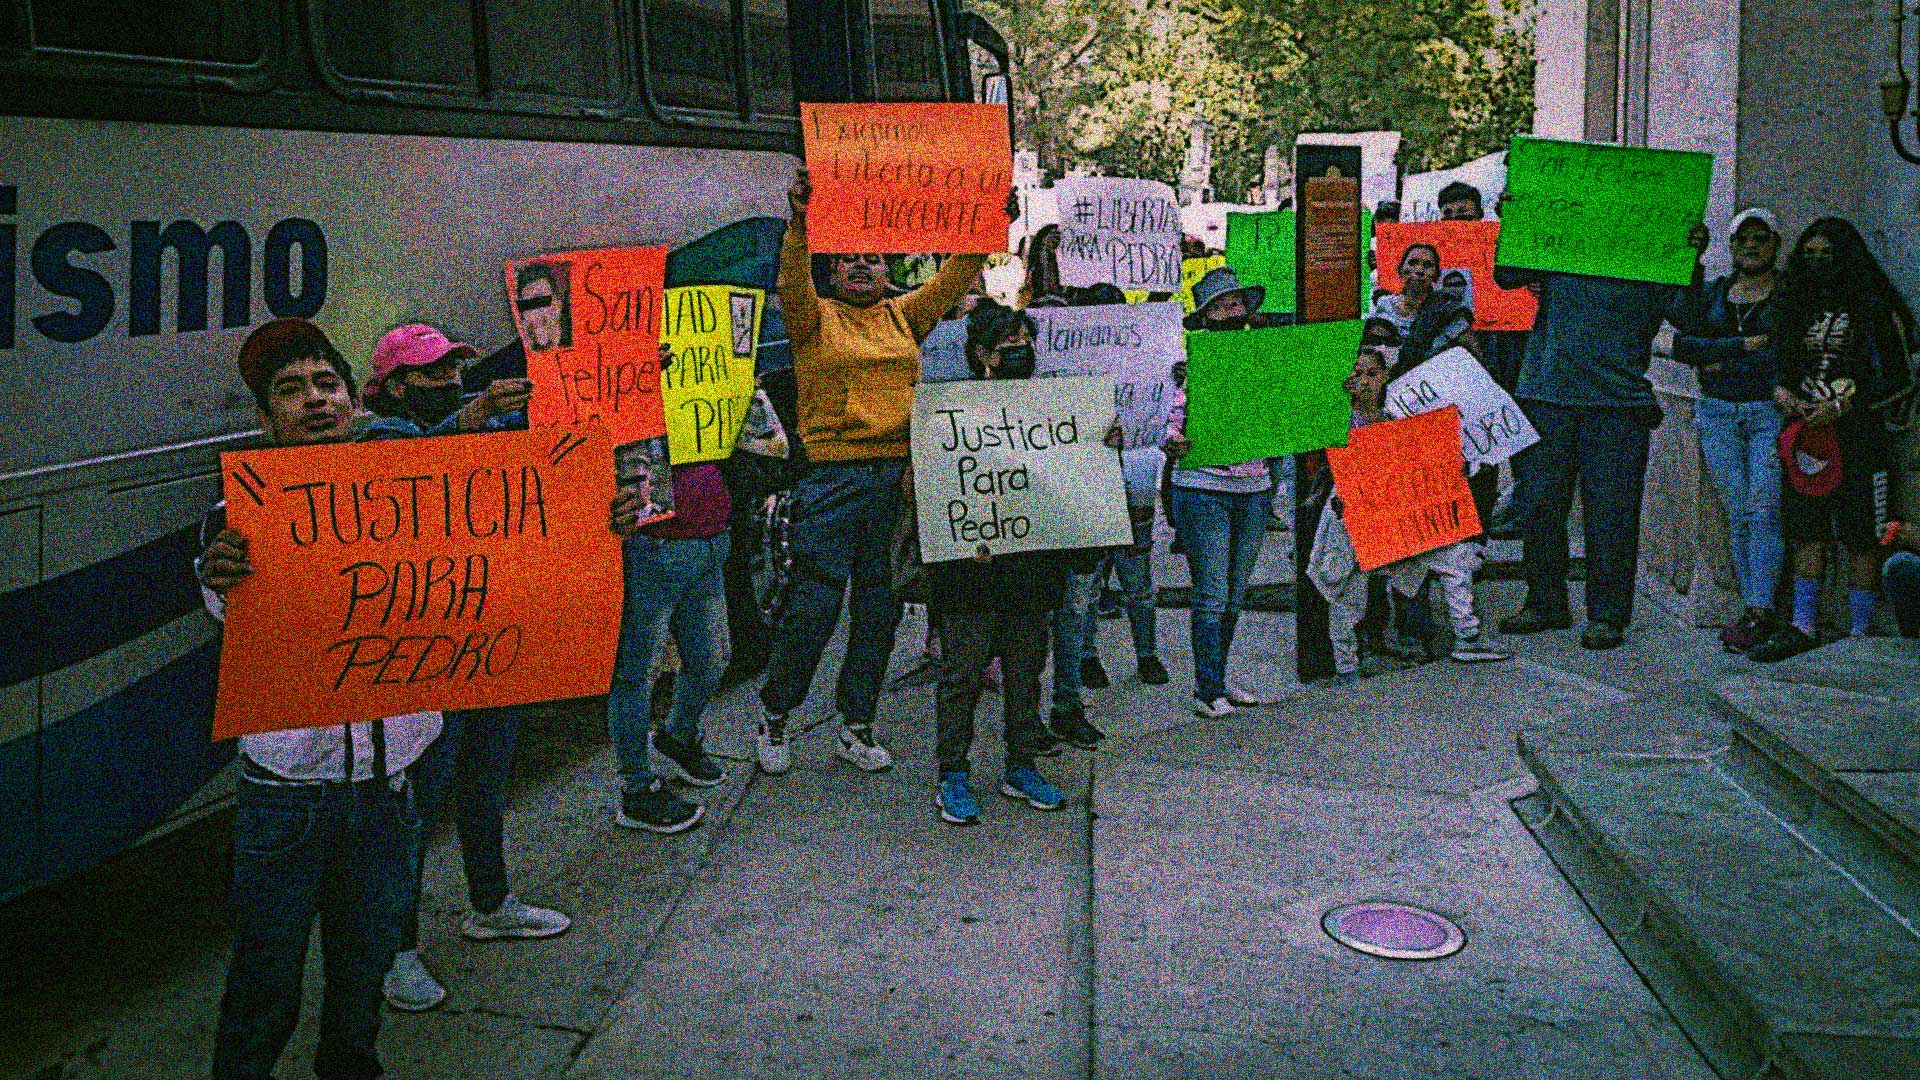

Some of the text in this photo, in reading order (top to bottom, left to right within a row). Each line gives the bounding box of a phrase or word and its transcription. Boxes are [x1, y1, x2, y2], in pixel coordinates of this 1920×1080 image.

[0, 186, 327, 348] ismo
[1105, 237, 1182, 286] PEDRO
[584, 263, 654, 335] San
[555, 344, 655, 412] Felipe
[935, 407, 1078, 452] Justicia
[958, 455, 1029, 496] Para
[947, 499, 1031, 542] Pedro
[339, 554, 489, 631] PARA
[327, 625, 523, 692] PEDRO
